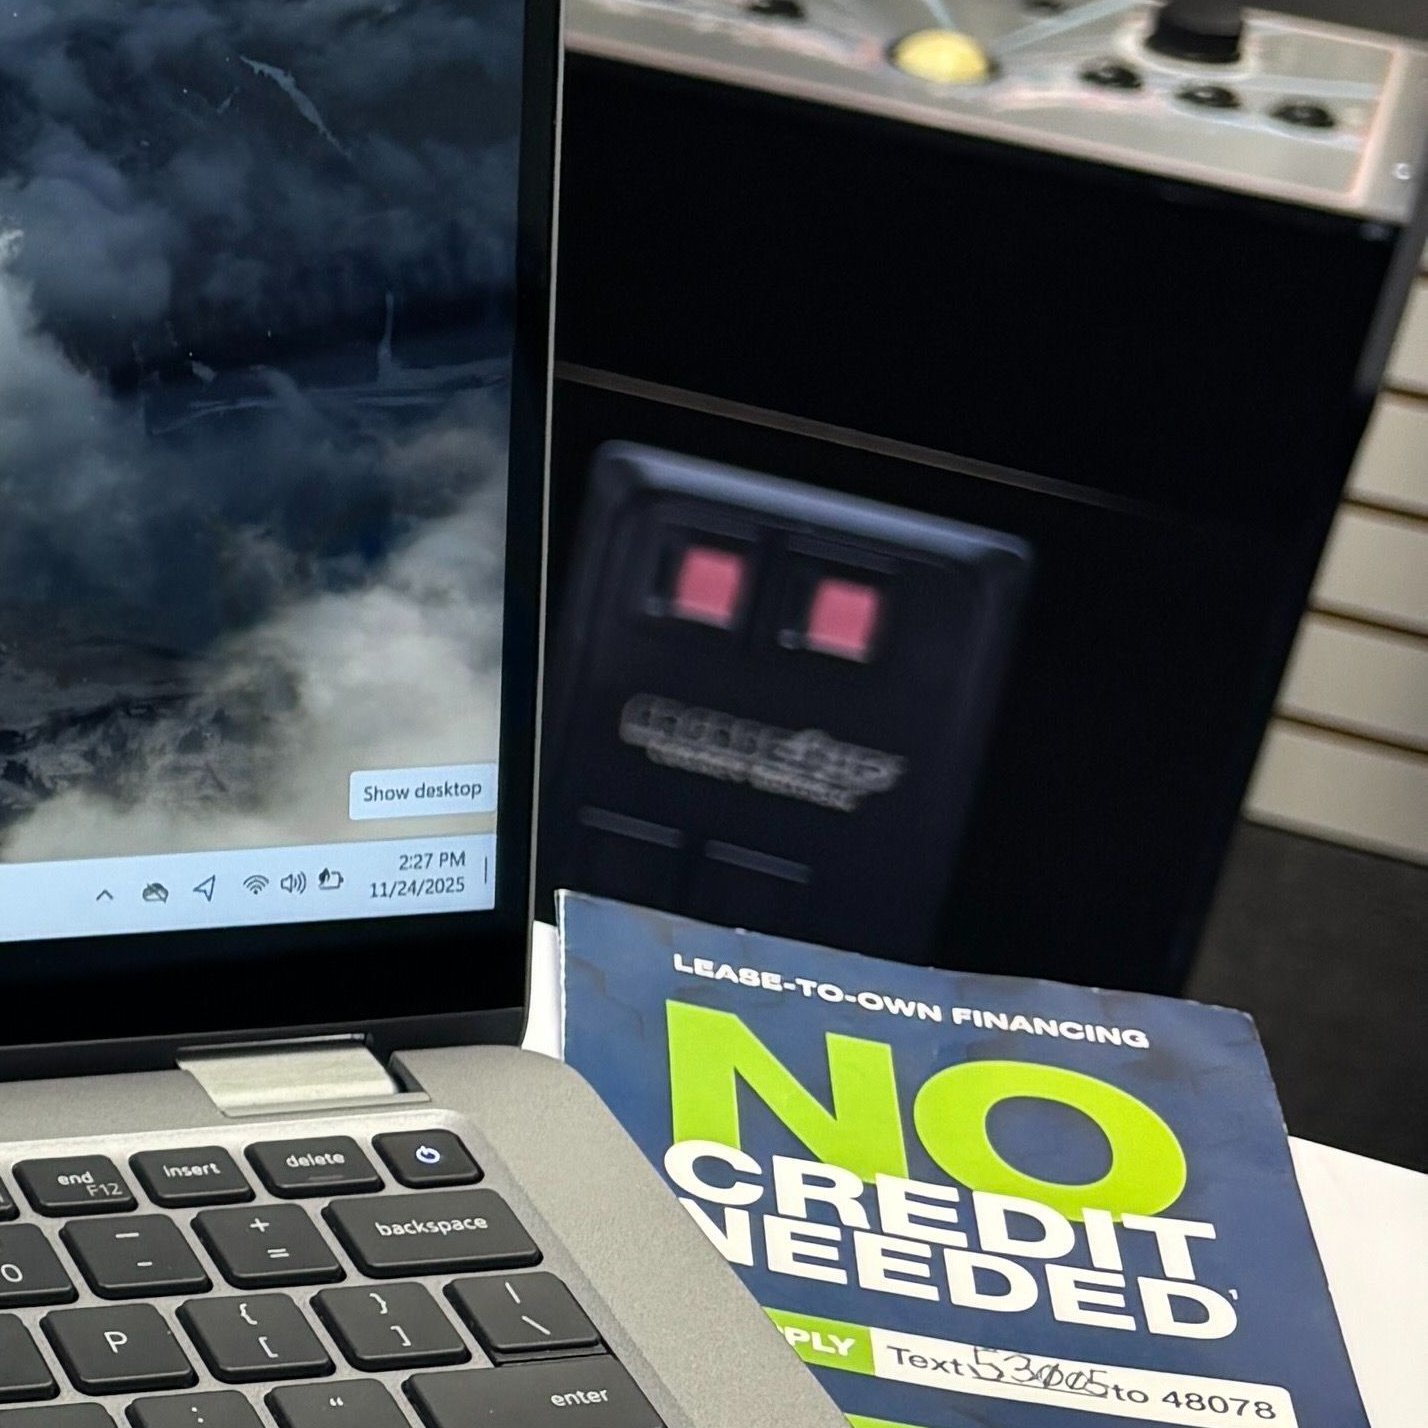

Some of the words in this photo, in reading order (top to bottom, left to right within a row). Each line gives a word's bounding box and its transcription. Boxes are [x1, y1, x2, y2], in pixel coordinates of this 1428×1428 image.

[364, 786, 409, 801] Show
[415, 781, 481, 799] desktop
[400, 853, 433, 870] 2:27
[440, 851, 465, 867] PM
[372, 877, 464, 898] 11/24/2025
[674, 953, 942, 1024] LEASE-TO-OWN
[951, 1004, 1150, 1049] FINANCING
[665, 999, 1187, 1222] NO
[163, 1163, 220, 1176] insert
[287, 1154, 344, 1167] delete
[58, 1172, 94, 1185] end
[663, 1139, 1216, 1281] CREDIT
[375, 1218, 488, 1235] backspace
[104, 1332, 127, 1353] P
[778, 1327, 856, 1357] PLY
[887, 1346, 962, 1376] Text
[1111, 1379, 1149, 1404] to
[1162, 1389, 1277, 1422] 48078
[551, 1390, 608, 1406] enter
